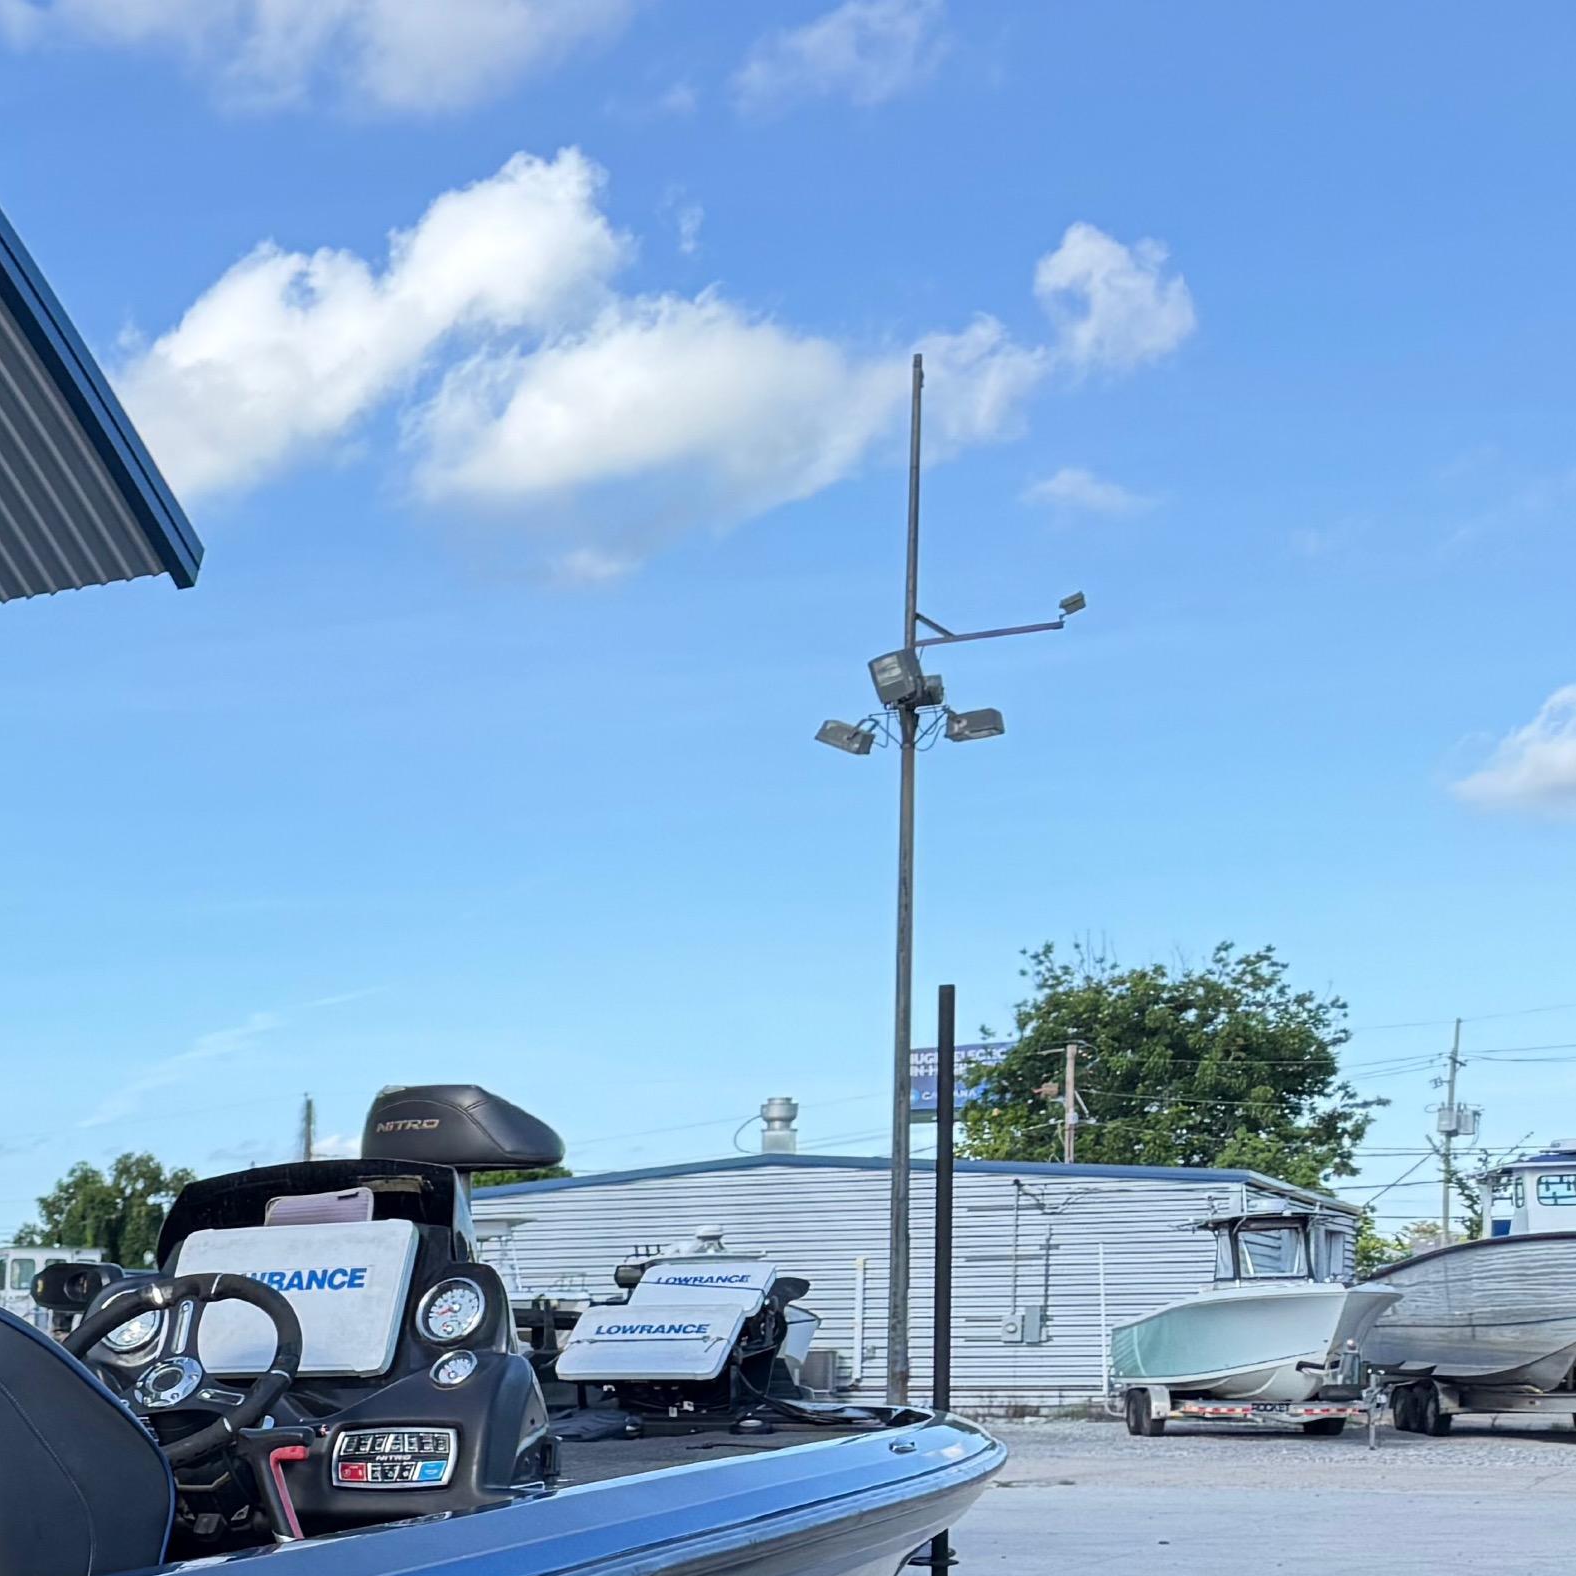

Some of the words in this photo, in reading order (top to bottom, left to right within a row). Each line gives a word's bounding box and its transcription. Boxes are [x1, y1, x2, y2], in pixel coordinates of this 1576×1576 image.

[376, 1119, 440, 1133] NITRO
[247, 1267, 368, 1292] WRANCE
[656, 1274, 751, 1285] LOWRANCE
[595, 1323, 711, 1335] LOWRANCE
[1251, 1402, 1291, 1413] ROCKET
